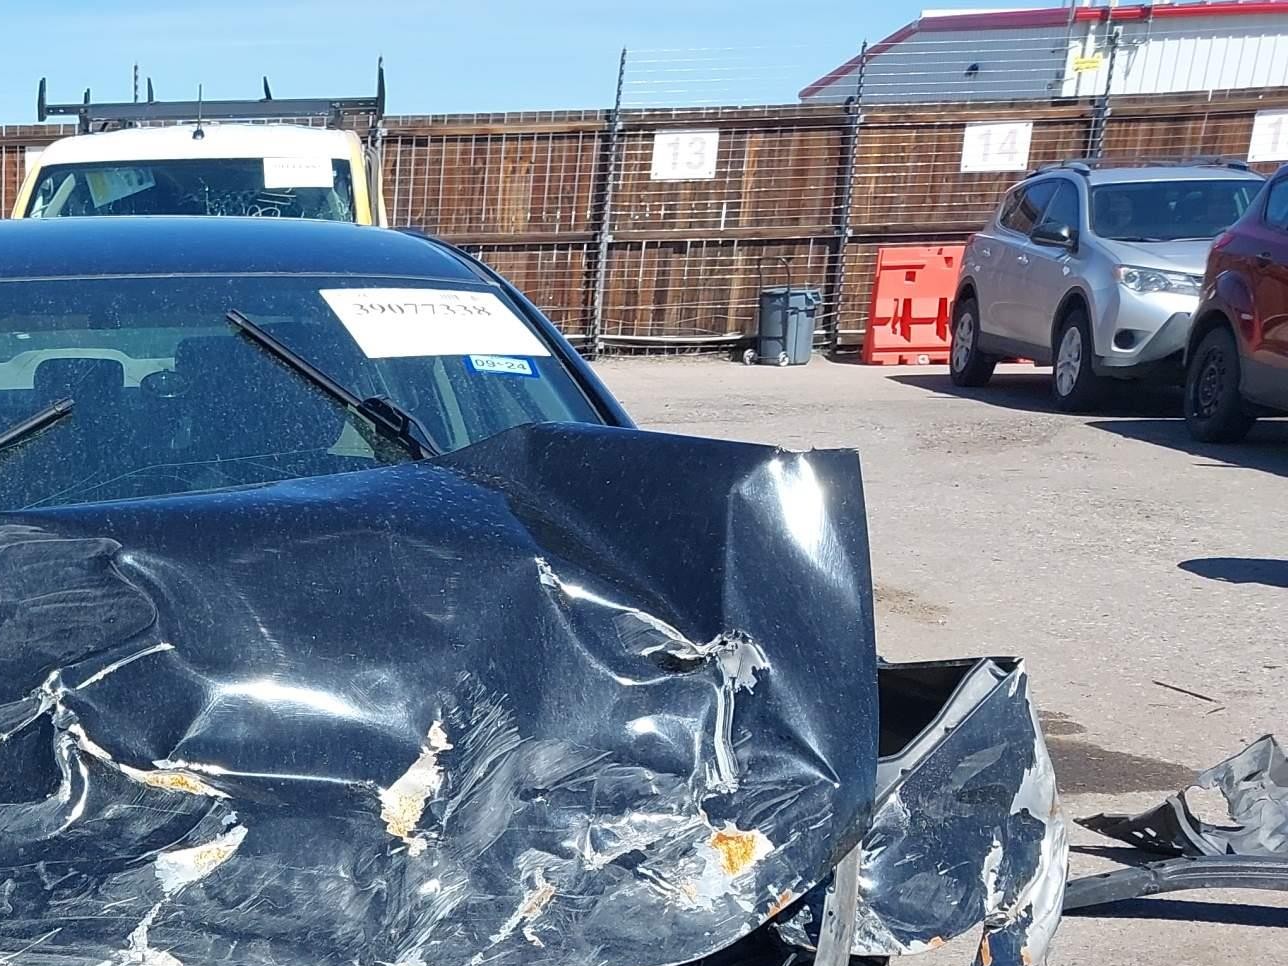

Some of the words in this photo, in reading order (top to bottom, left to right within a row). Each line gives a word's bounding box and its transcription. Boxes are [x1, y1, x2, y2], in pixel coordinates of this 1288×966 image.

[666, 136, 707, 171] 13
[978, 128, 1019, 163] 14
[353, 303, 492, 316] 39077338
[474, 358, 528, 371] 09-24
